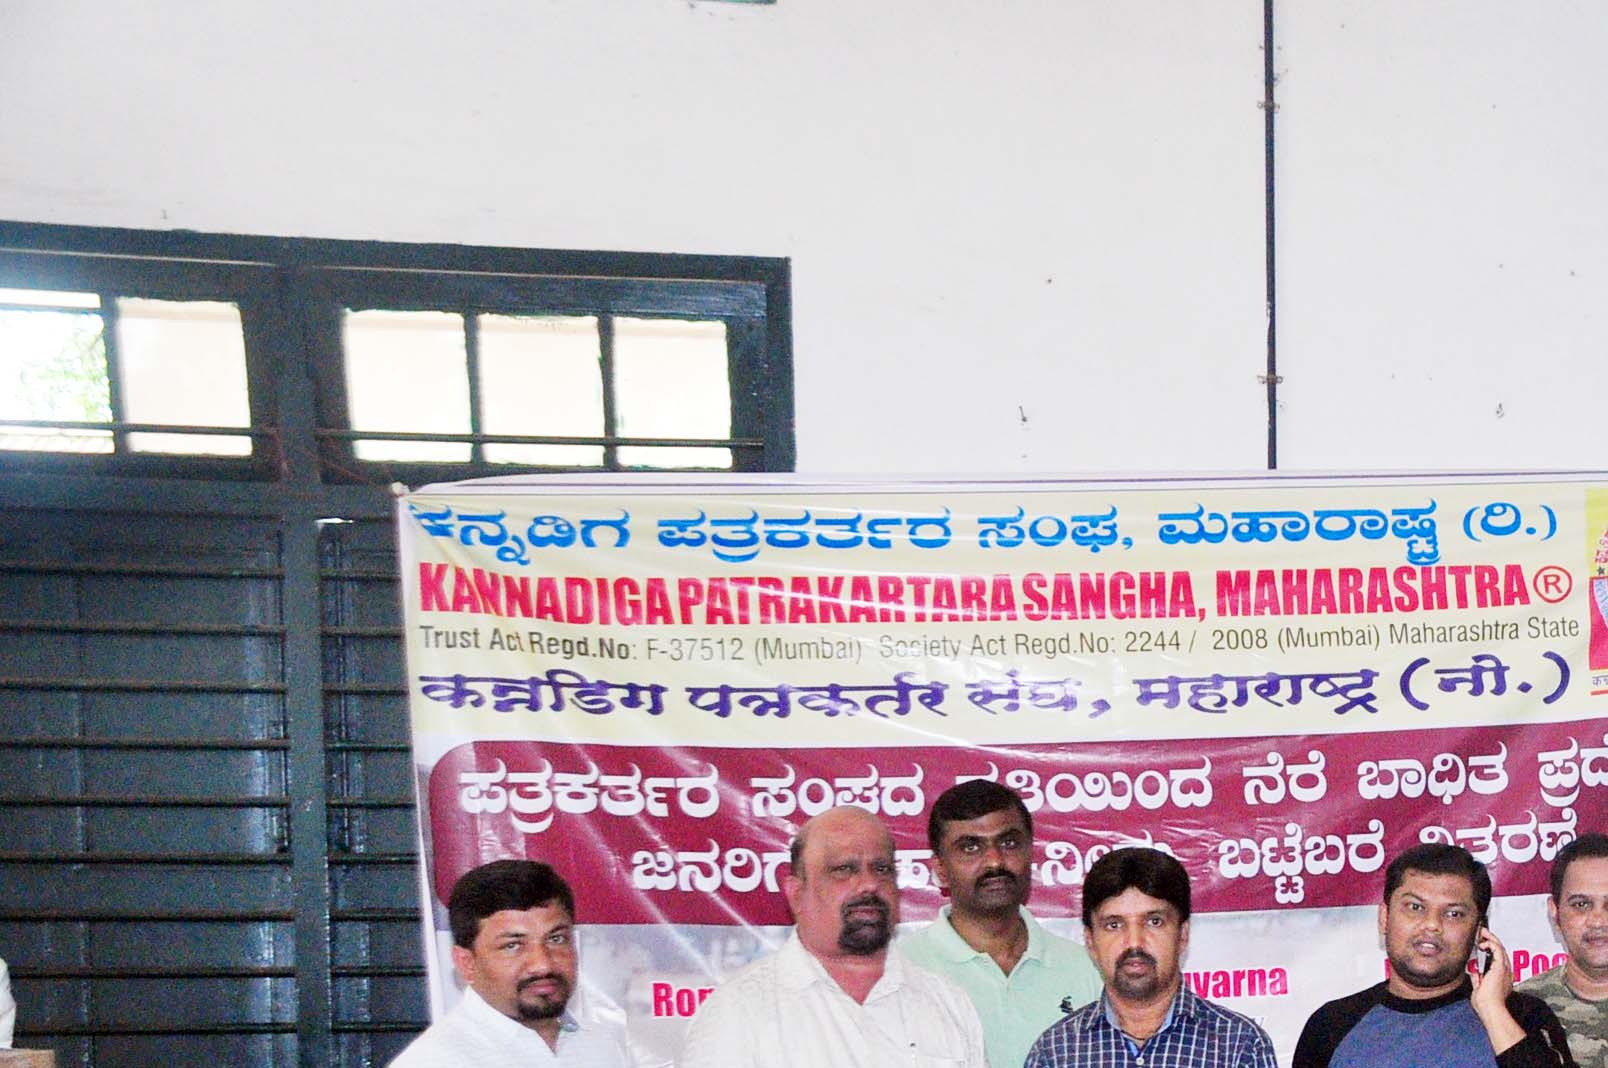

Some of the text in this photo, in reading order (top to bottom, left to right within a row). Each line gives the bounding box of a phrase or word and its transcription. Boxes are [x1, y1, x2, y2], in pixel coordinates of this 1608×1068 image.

[656, 506, 952, 563] ಪತ್ರಕರ್ತರ
[977, 504, 1133, 553] ಸಂಘ,
[1158, 498, 1442, 566] ಮಹಾರಾಷ್ಟ್ರ
[1463, 501, 1558, 542] (ರಿ.)
[418, 562, 676, 626] KANNADIGA
[678, 573, 1017, 626] PATRAKARTARA
[1022, 570, 1207, 622] SANGHA,
[420, 626, 479, 649] Trust
[490, 628, 522, 652] Act
[531, 631, 637, 660] Regd.No:
[647, 639, 744, 661] F-37512
[755, 638, 862, 666] (Mumbai)
[880, 634, 961, 659] Society
[971, 635, 1007, 656] Act
[1015, 632, 1115, 659] Regd.No:
[1125, 630, 1181, 652] 2244
[1212, 628, 1268, 651] 2008
[1278, 624, 1380, 654] (Mumbai)
[1389, 620, 1520, 644] Maharashtra
[1527, 616, 1580, 639] State
[459, 758, 719, 833] ಪತ್ರಕರ್ತರ
[1242, 750, 1328, 807] ನೆರೆ
[1218, 818, 1385, 904] ಬಟ್ಟೆಬರೆ
